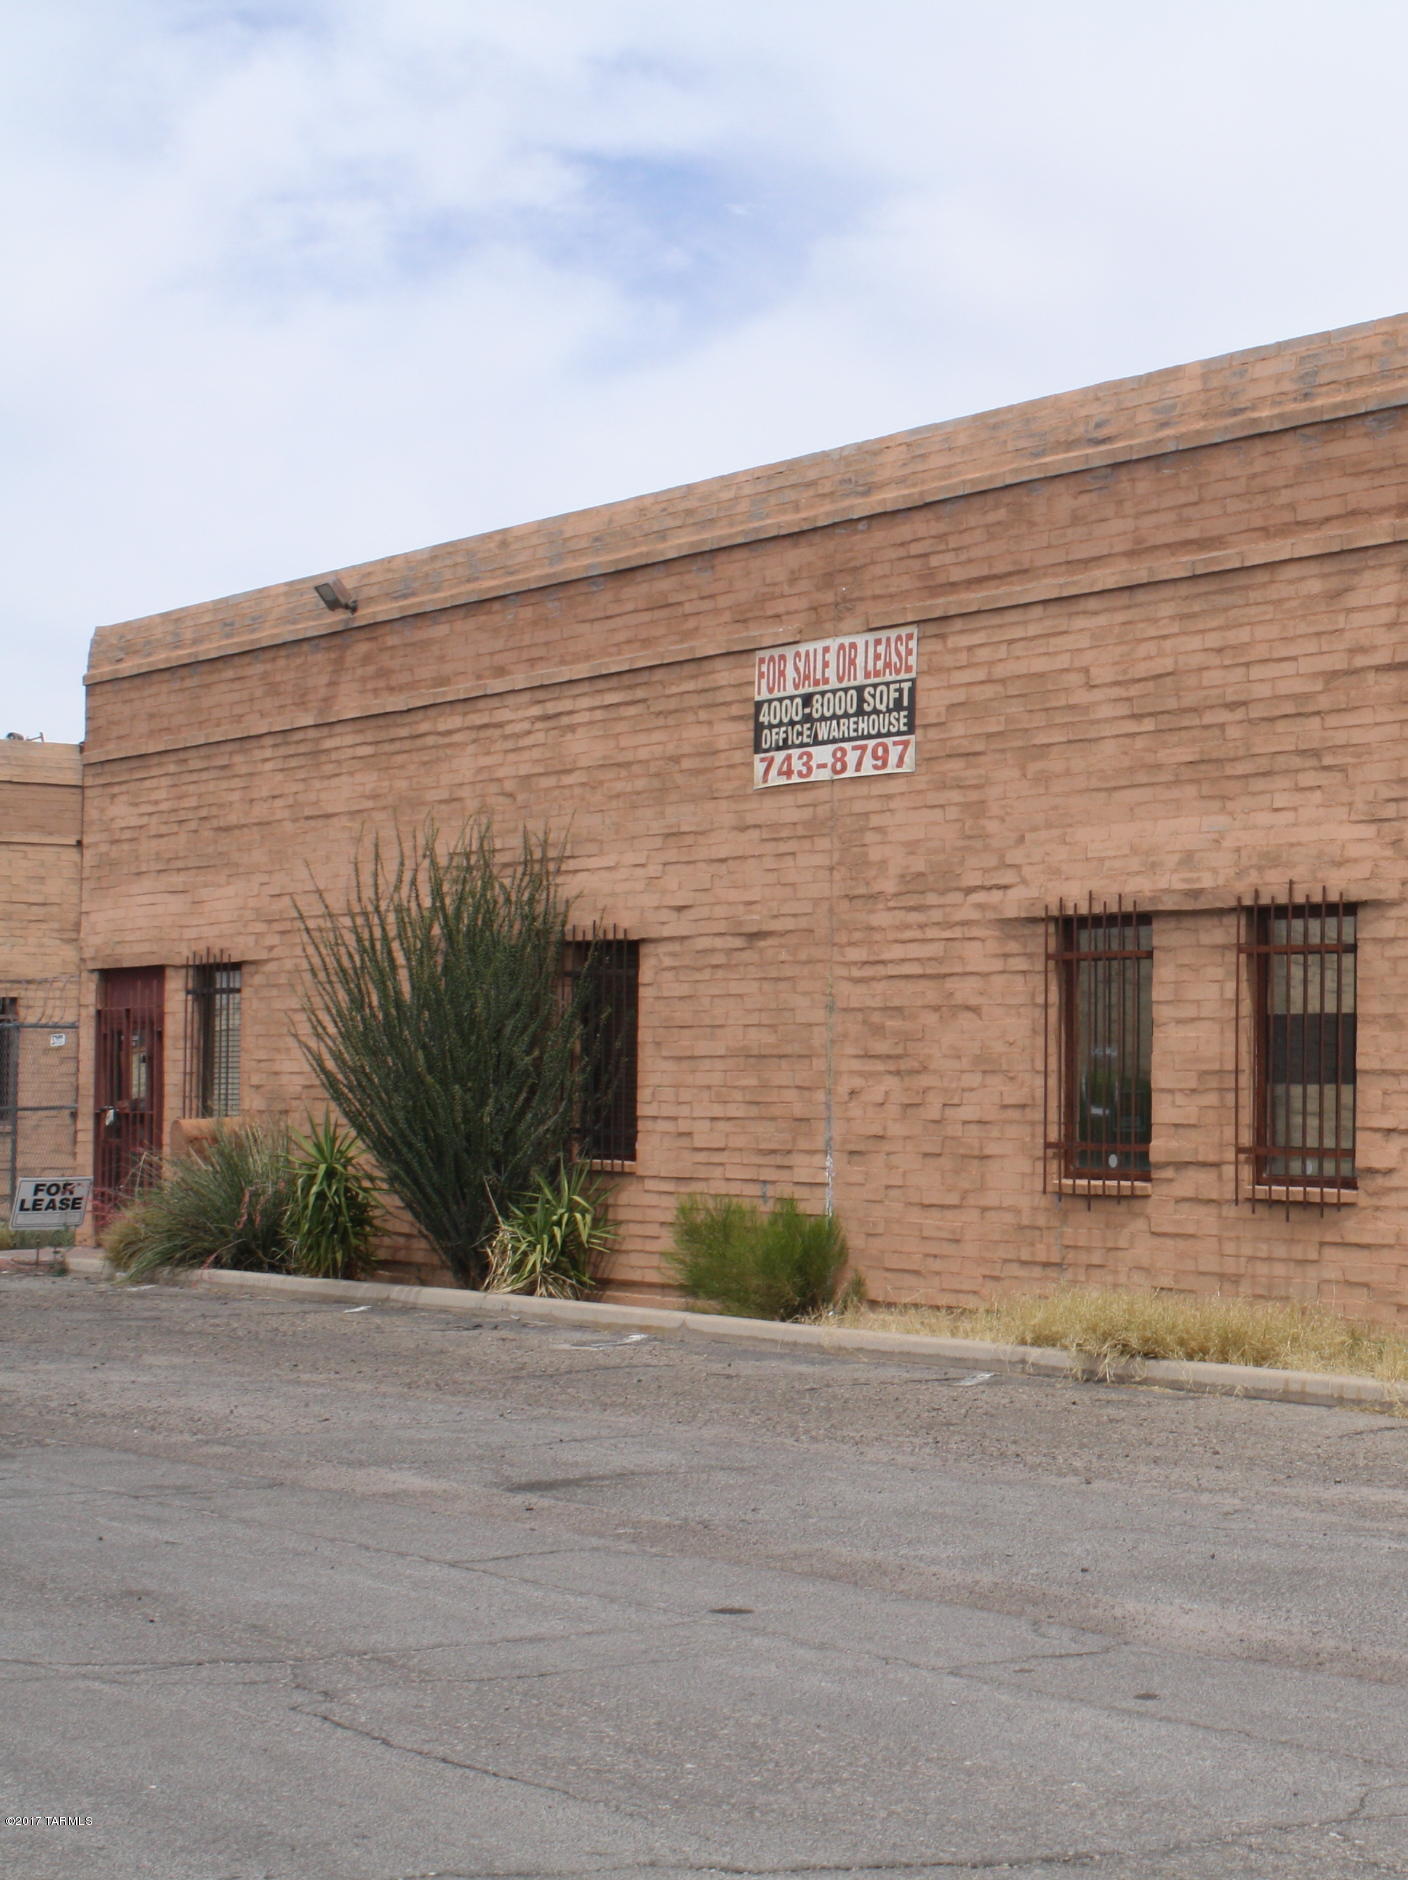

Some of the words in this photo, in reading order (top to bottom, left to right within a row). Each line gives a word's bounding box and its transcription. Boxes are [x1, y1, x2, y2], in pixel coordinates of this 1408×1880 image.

[756, 653, 787, 697] FOR
[792, 645, 830, 691] SALE
[836, 641, 858, 685] OR
[864, 633, 914, 679] LEASE
[758, 689, 858, 726] 4000-8000
[863, 682, 912, 711] SQFT
[761, 710, 909, 749] OFFICE/WAREHOUSE
[759, 739, 911, 784] 743-8797
[19, 1197, 83, 1211] LEASE
[33, 1183, 75, 1196] FOR
